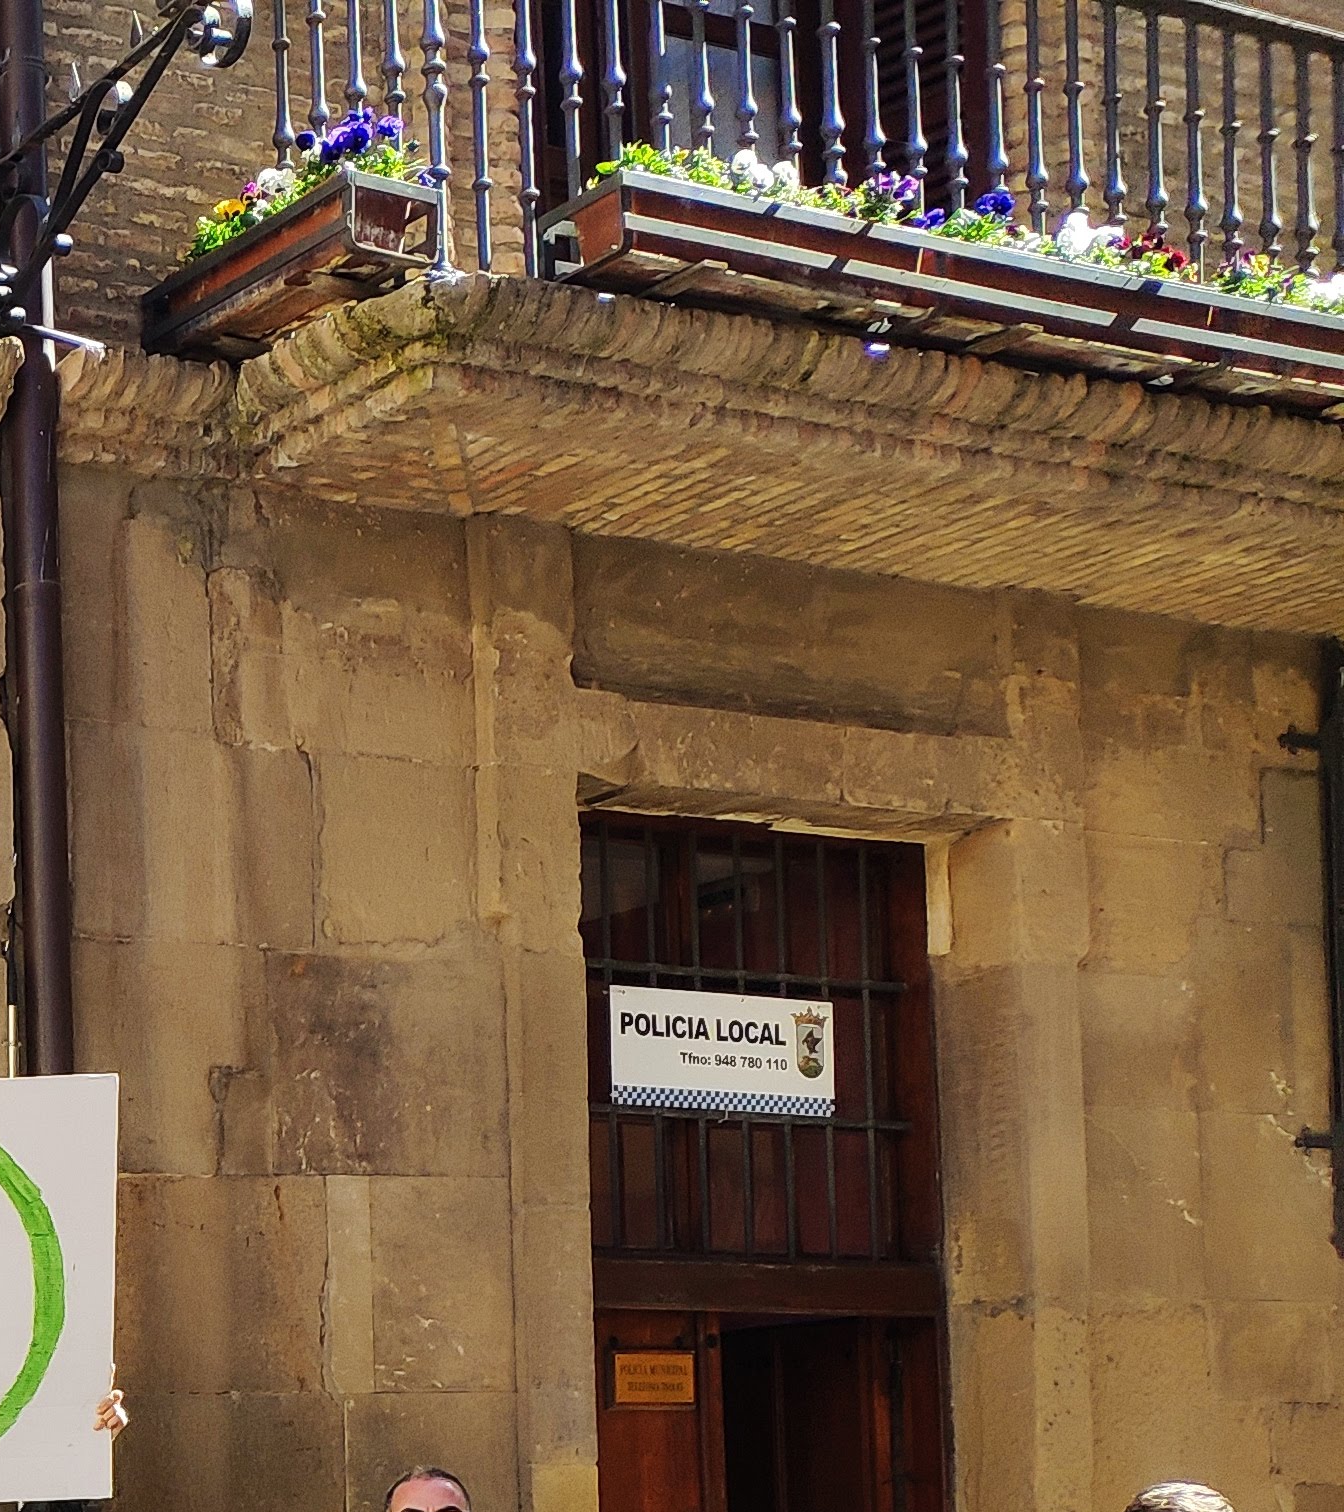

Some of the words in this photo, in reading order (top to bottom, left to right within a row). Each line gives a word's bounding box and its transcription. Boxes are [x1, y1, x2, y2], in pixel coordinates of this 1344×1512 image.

[620, 1012, 710, 1040] POLICIA
[716, 1018, 787, 1046] LOCAL
[680, 1052, 711, 1066] Tfno:
[714, 1053, 737, 1067] 948
[740, 1056, 762, 1069] 780
[766, 1057, 787, 1070] 110
